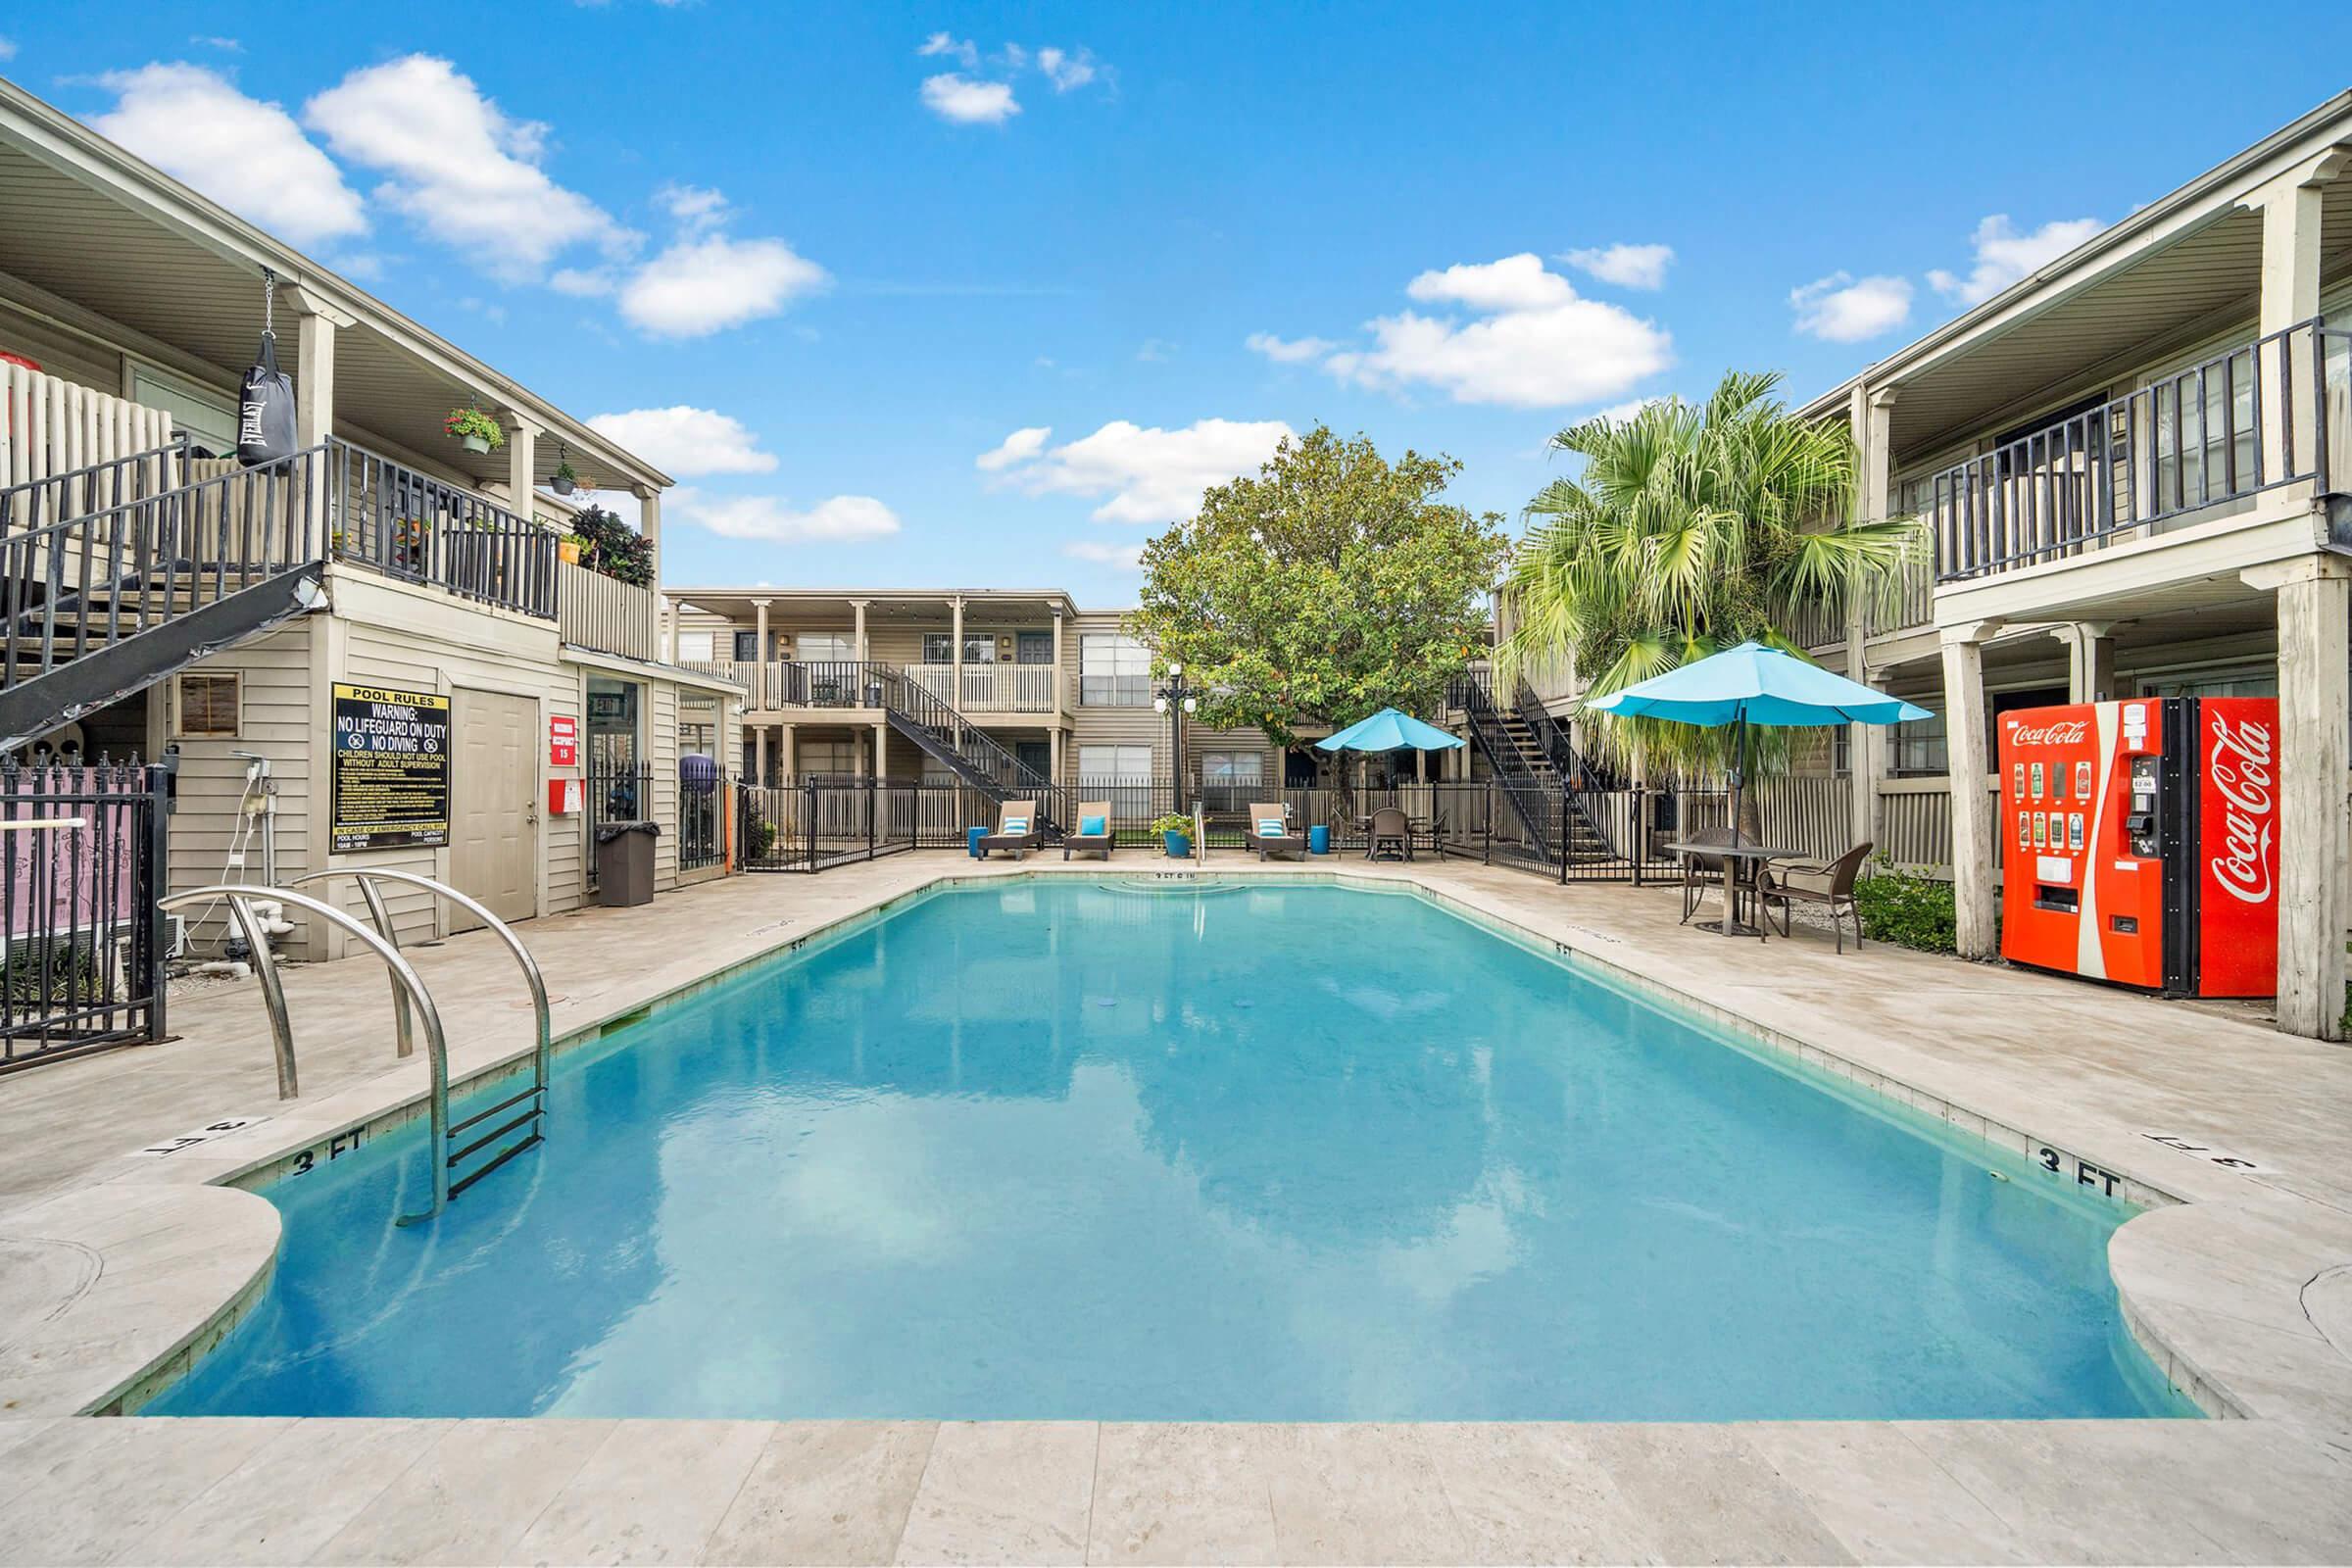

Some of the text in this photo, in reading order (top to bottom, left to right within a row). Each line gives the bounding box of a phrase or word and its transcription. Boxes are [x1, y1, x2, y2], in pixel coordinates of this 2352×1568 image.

[240, 401, 268, 447] EVERLAST
[353, 688, 435, 707] POOL RULES
[371, 703, 418, 721] WARNING:
[337, 715, 447, 739] NO LIFEGUARD ON DUTY
[2012, 720, 2091, 747] Coca-Cola
[371, 735, 418, 753] NO DIVING
[337, 750, 373, 760] CHILDREN
[374, 751, 401, 760] SHOULD
[402, 752, 416, 761] NOT
[416, 753, 429, 762] USE
[560, 749, 568, 760] 15
[343, 759, 374, 768] WITHOUT
[377, 760, 399, 769] ADULT
[400, 760, 441, 770] SUPERVISION
[2211, 709, 2273, 904] Coca-Cola
[205, 1121, 246, 1131] 3
[293, 1125, 367, 1176] 3 FT
[2039, 1148, 2121, 1198] 3 FT
